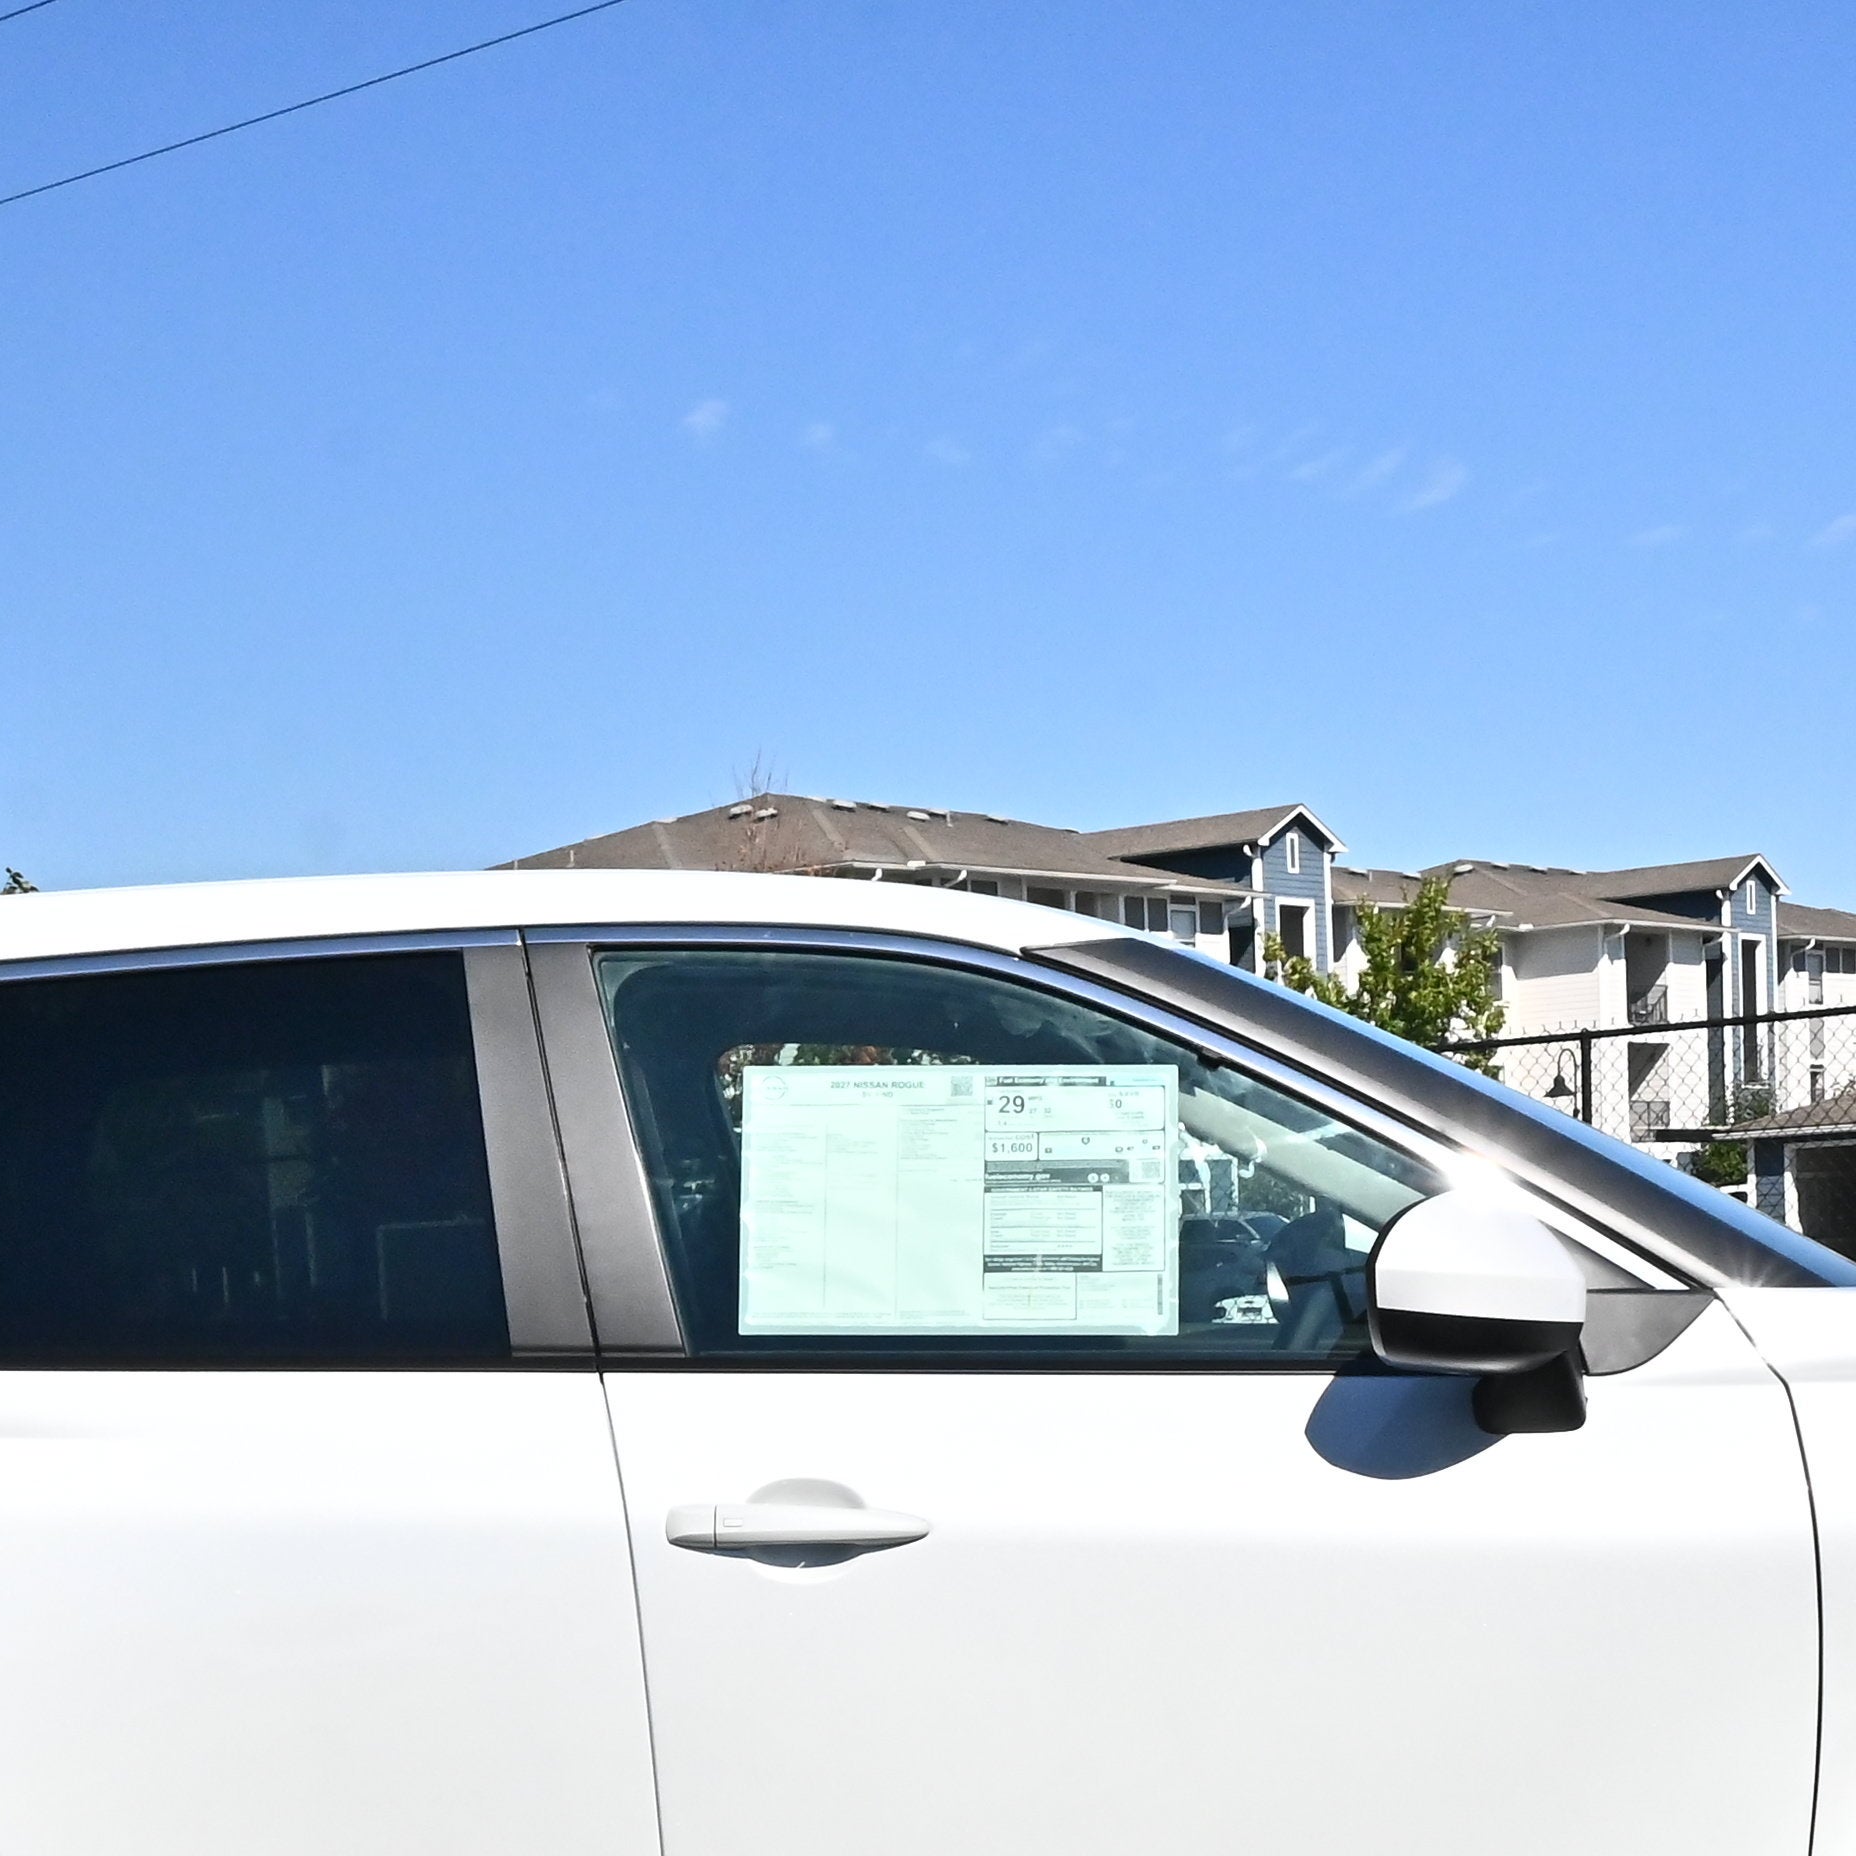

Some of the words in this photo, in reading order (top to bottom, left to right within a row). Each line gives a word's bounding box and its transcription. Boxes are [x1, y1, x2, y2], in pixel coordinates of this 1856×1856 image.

[853, 1081, 888, 1089] NISSAN
[891, 1081, 924, 1089] ROGUE
[998, 1095, 1025, 1114] 29
[992, 1142, 1032, 1153] $1,600
